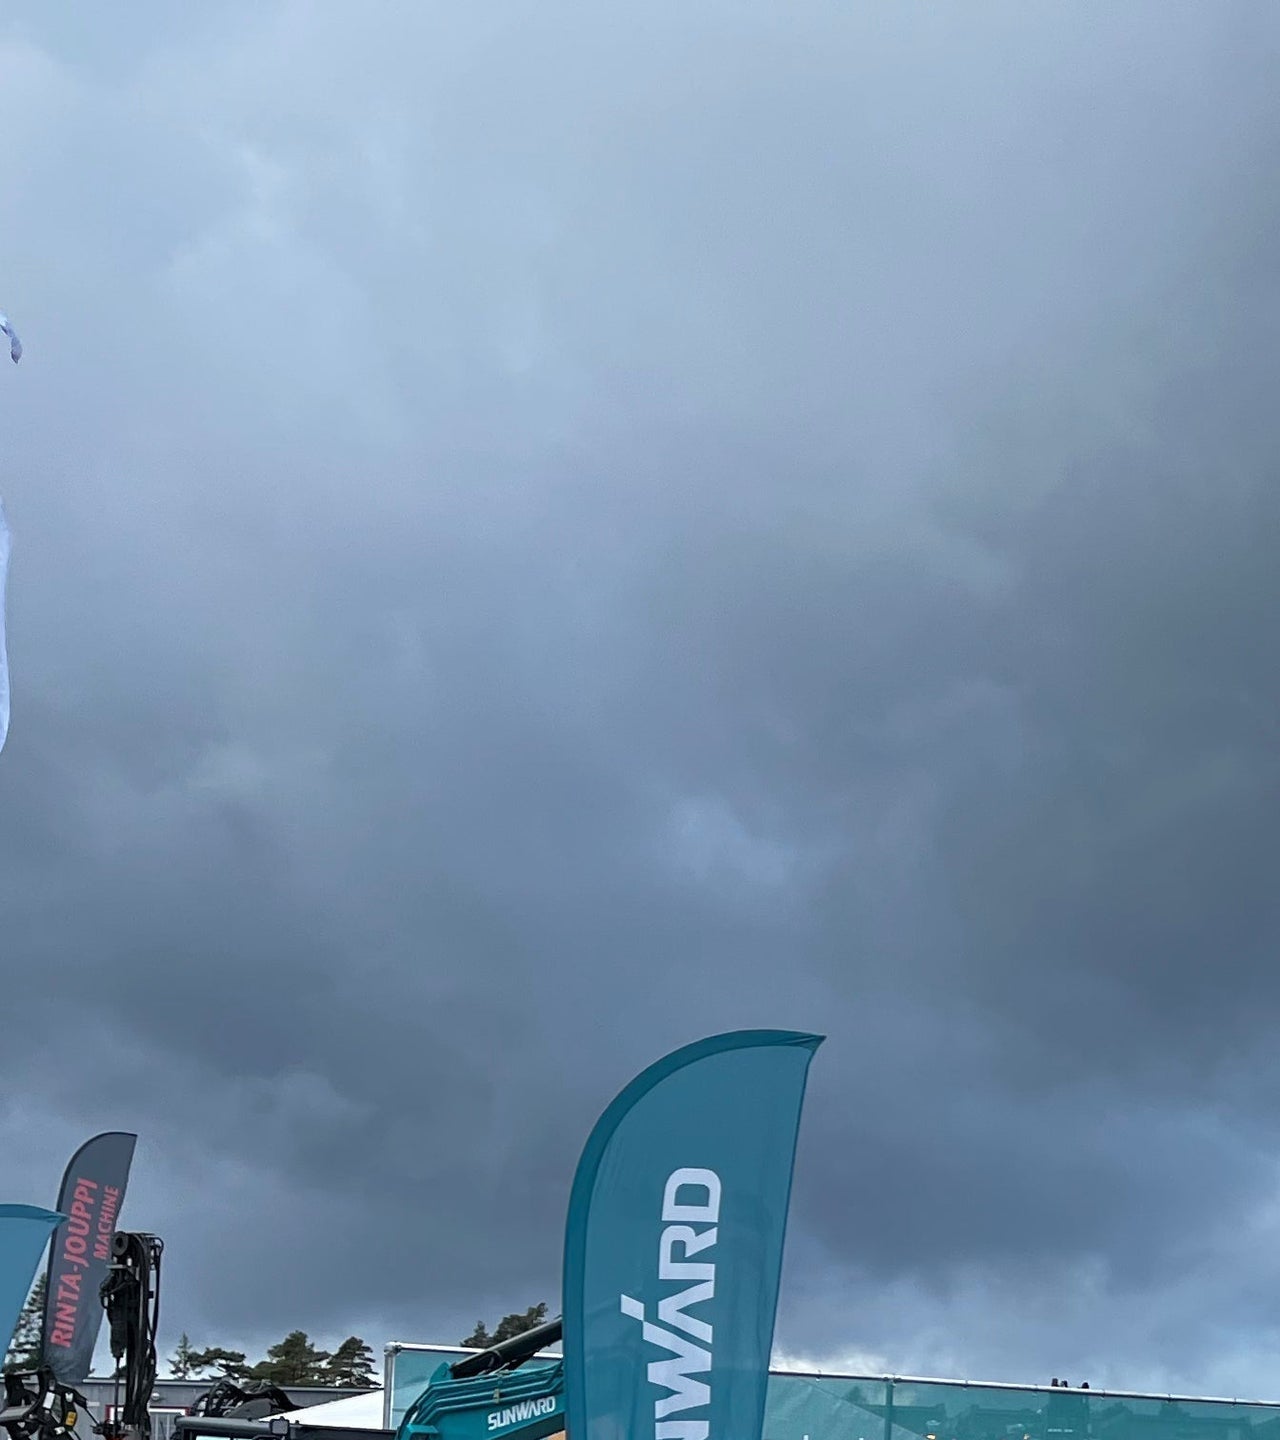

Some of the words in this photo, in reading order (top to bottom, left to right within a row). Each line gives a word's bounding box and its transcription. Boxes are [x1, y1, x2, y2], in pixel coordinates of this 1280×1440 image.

[93, 1184, 119, 1260] MACHINE
[51, 1177, 98, 1348] RINTA-JOUPPI
[487, 1396, 556, 1431] SUNWARD
